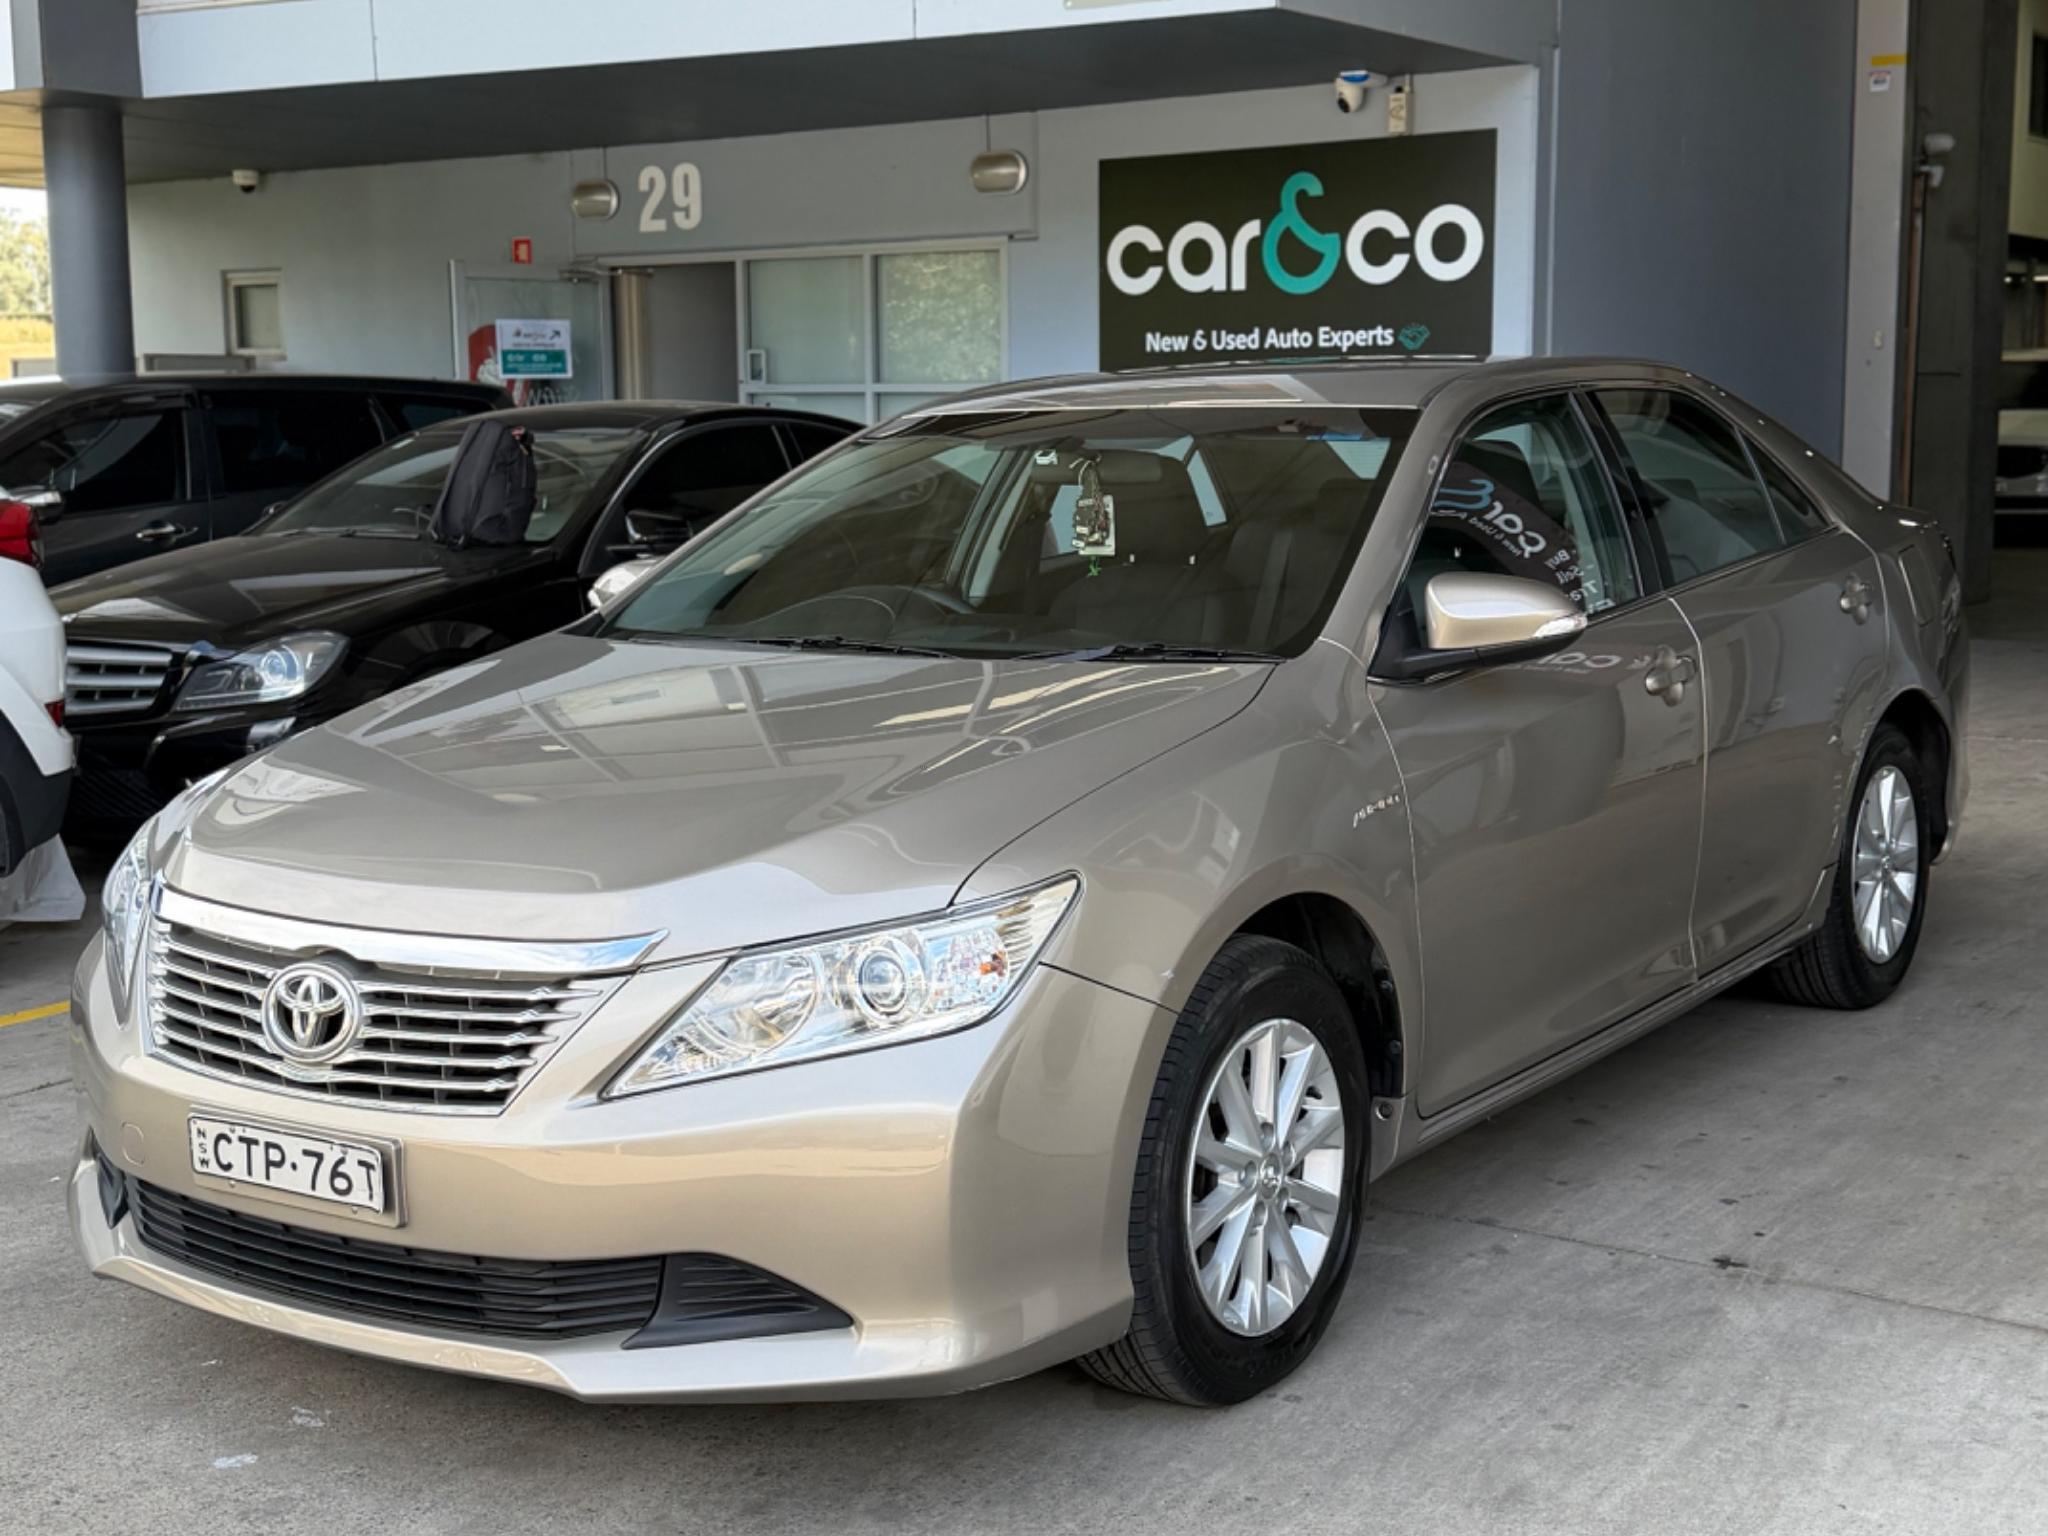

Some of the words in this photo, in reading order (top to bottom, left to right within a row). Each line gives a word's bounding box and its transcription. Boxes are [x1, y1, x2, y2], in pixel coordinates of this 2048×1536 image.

[638, 162, 703, 232] 29
[1145, 332, 1188, 352] New
[1193, 329, 1207, 350] &
[1211, 326, 1260, 350] Used
[1264, 327, 1313, 349] Auto
[1318, 325, 1395, 352] Experts
